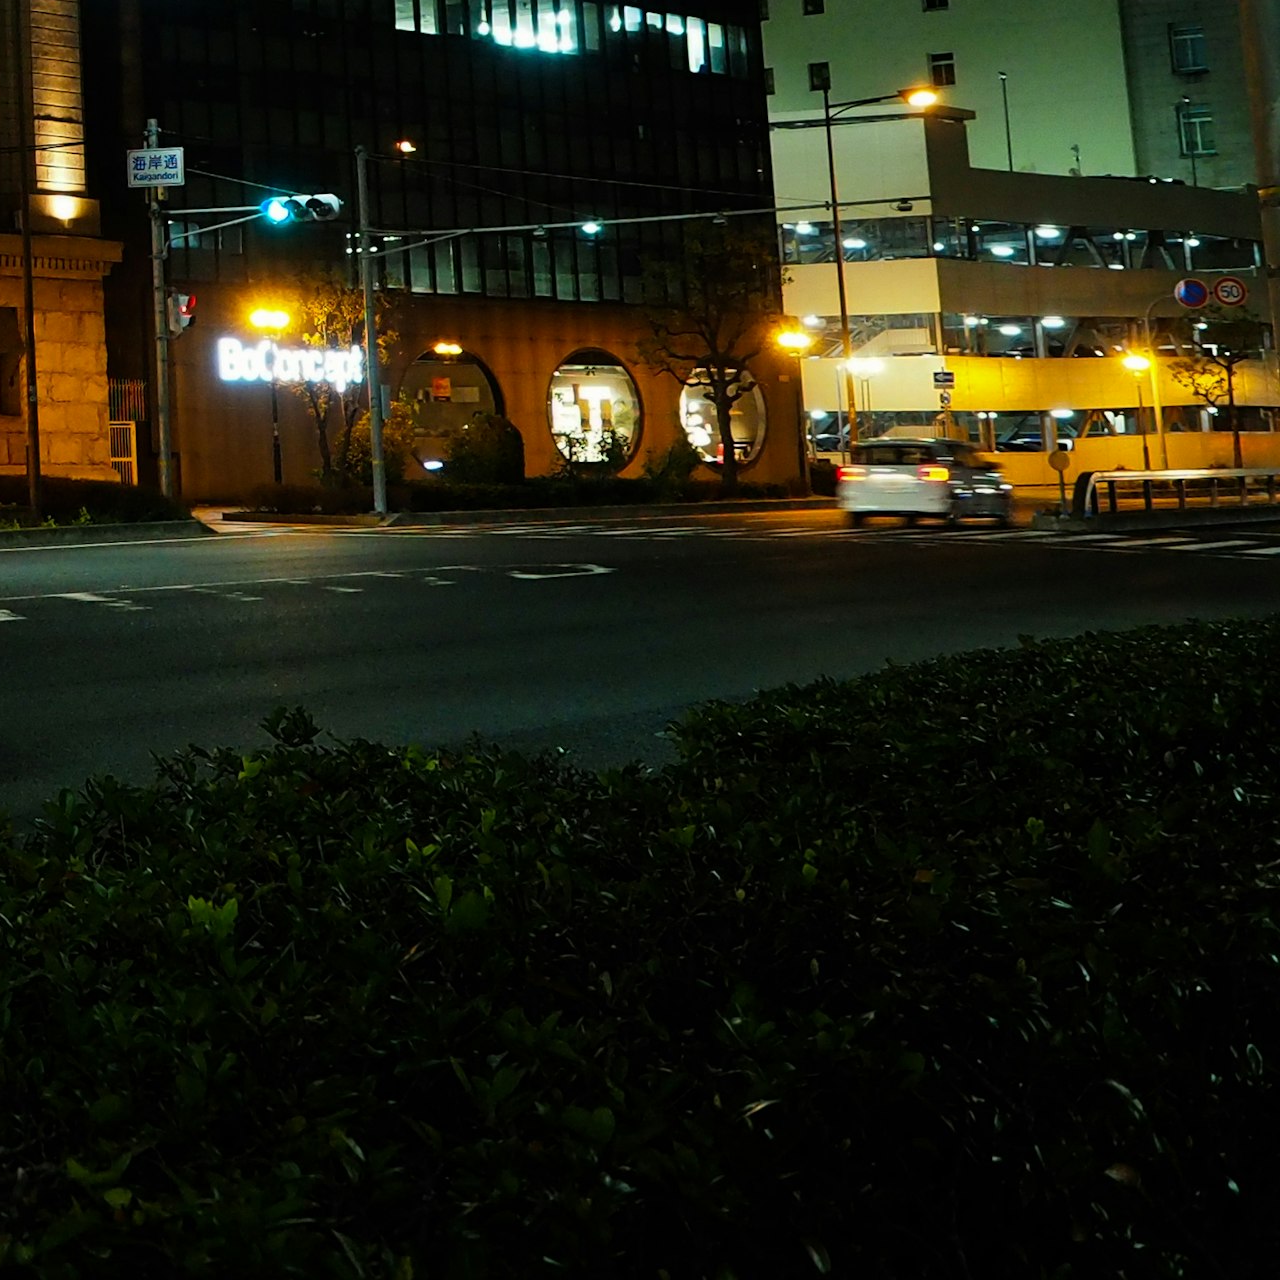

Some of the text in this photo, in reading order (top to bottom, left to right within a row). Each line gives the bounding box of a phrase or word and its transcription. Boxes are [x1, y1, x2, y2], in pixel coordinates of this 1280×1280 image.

[132, 154, 179, 171] 海岸通
[1220, 285, 1240, 298] 50
[218, 337, 363, 393] BoConcept
